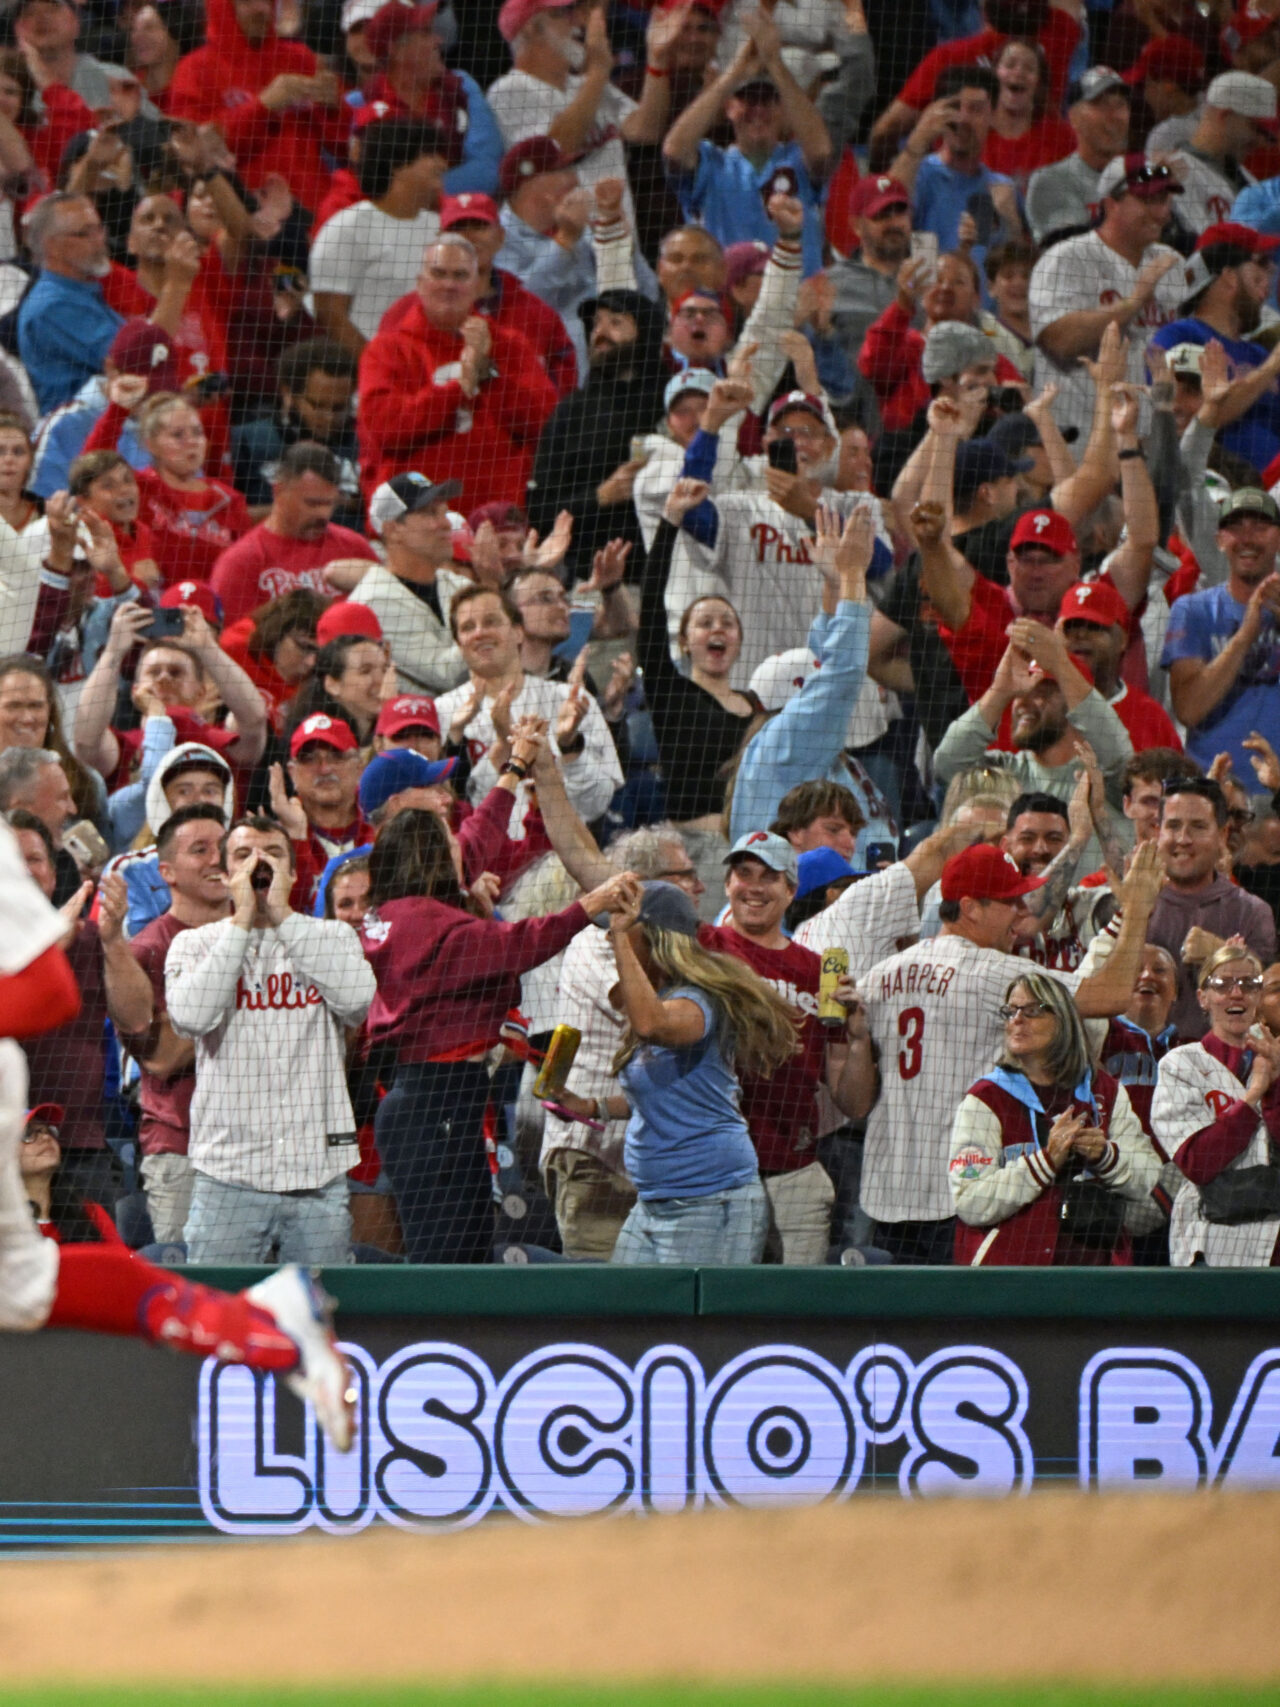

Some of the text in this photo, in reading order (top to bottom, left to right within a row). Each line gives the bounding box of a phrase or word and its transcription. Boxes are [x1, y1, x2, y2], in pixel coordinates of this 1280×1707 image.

[303, 714, 333, 736] P
[235, 971, 326, 1012] hillie
[880, 962, 957, 1003] HARPER
[897, 1005, 926, 1081] 3
[200, 1342, 1034, 1536] LISCIO'S
